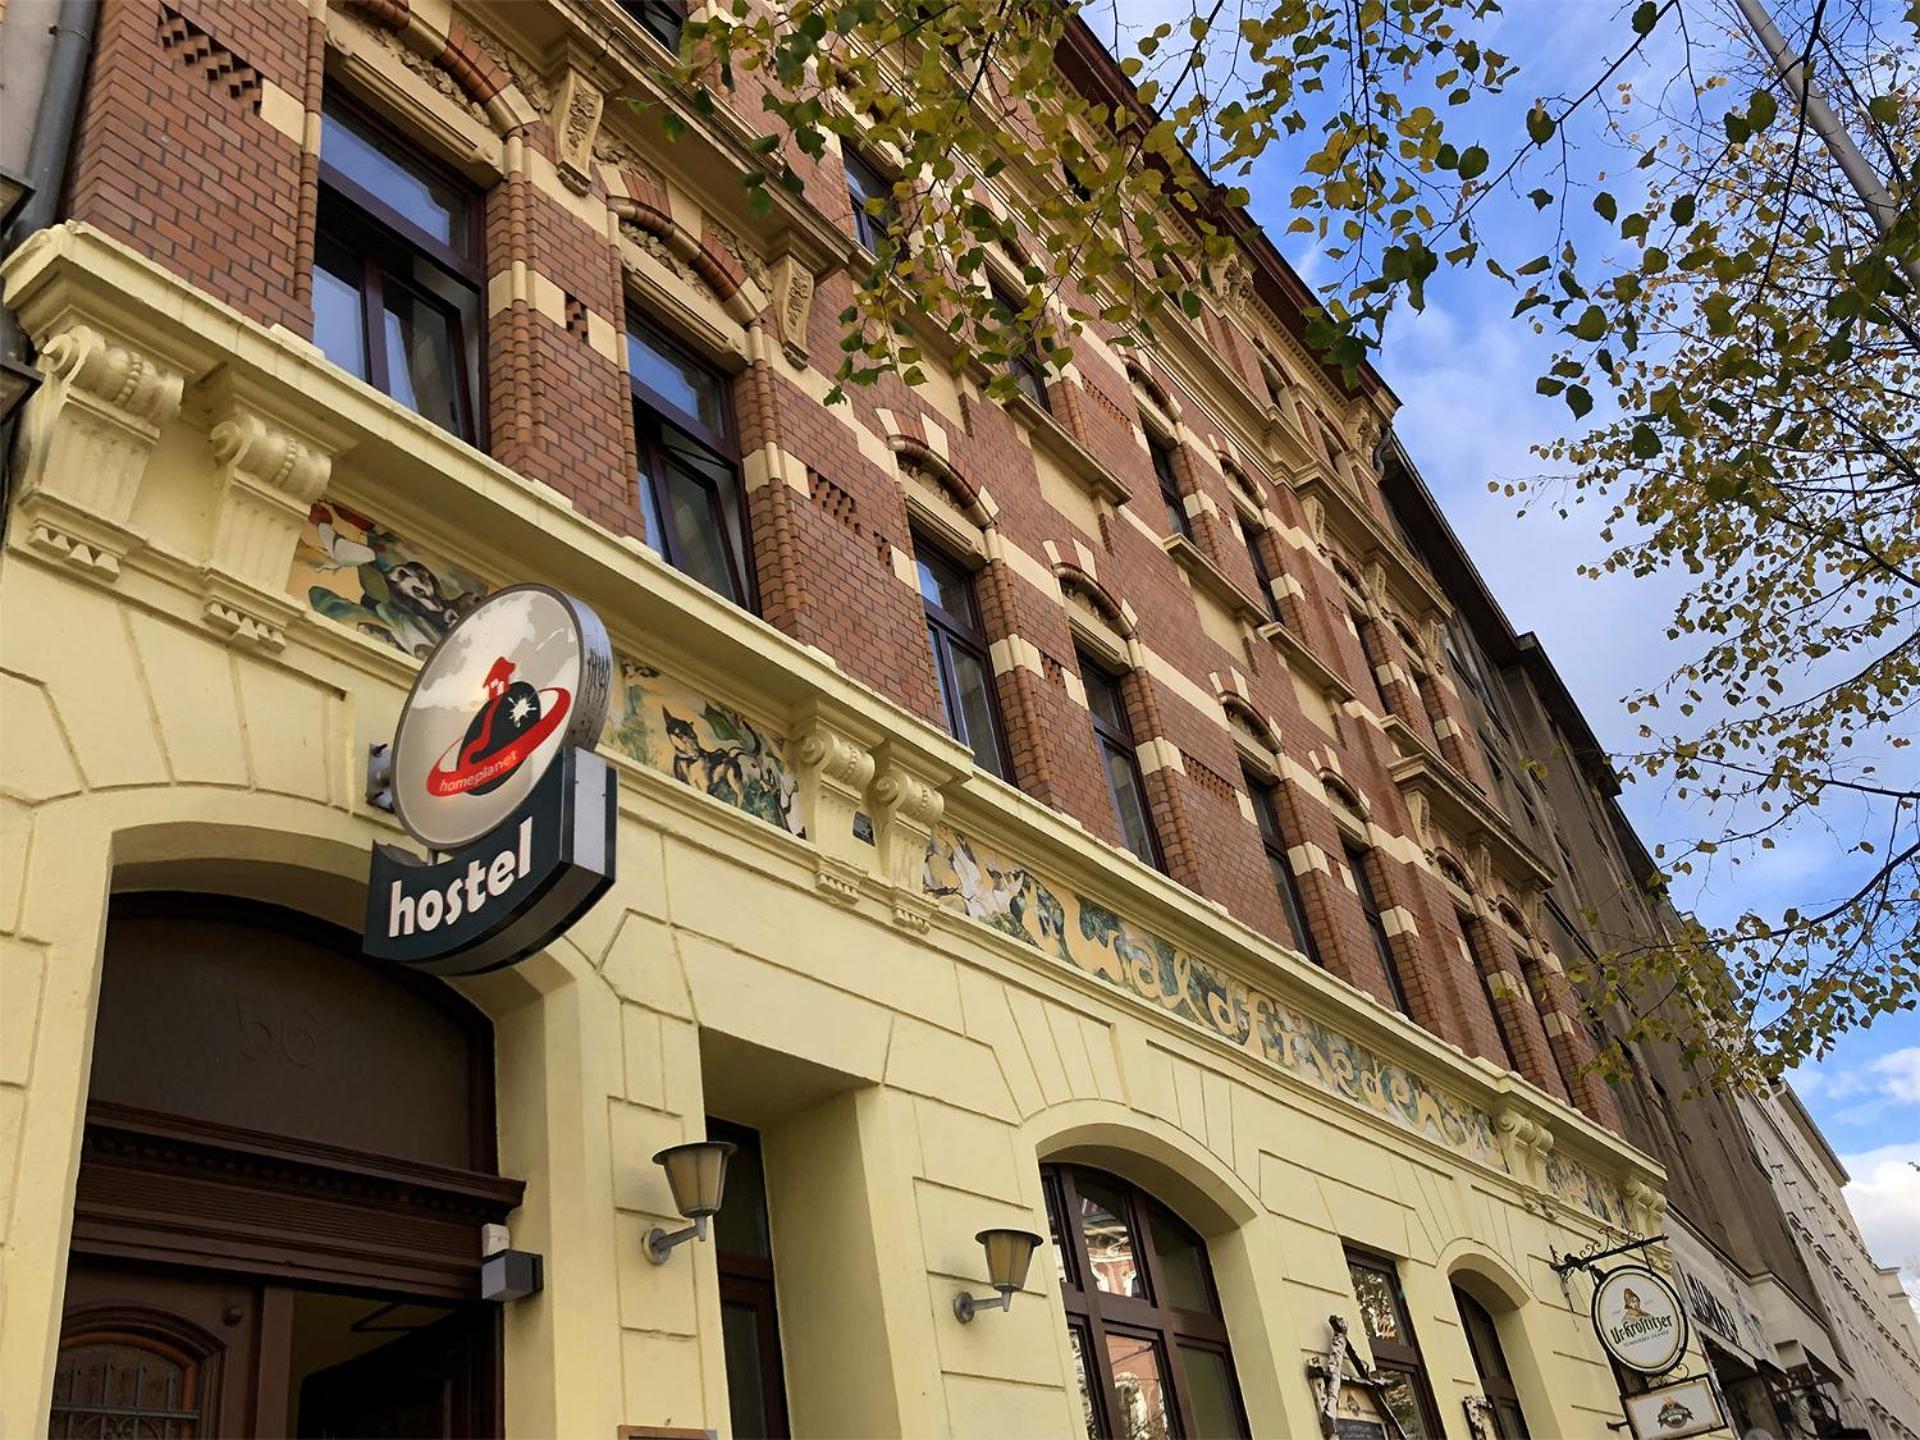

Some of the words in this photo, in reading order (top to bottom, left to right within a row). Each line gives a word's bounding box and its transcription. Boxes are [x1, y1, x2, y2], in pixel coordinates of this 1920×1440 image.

[439, 750, 517, 792] homeplanet
[389, 816, 533, 938] hostel
[234, 992, 320, 1070] 56
